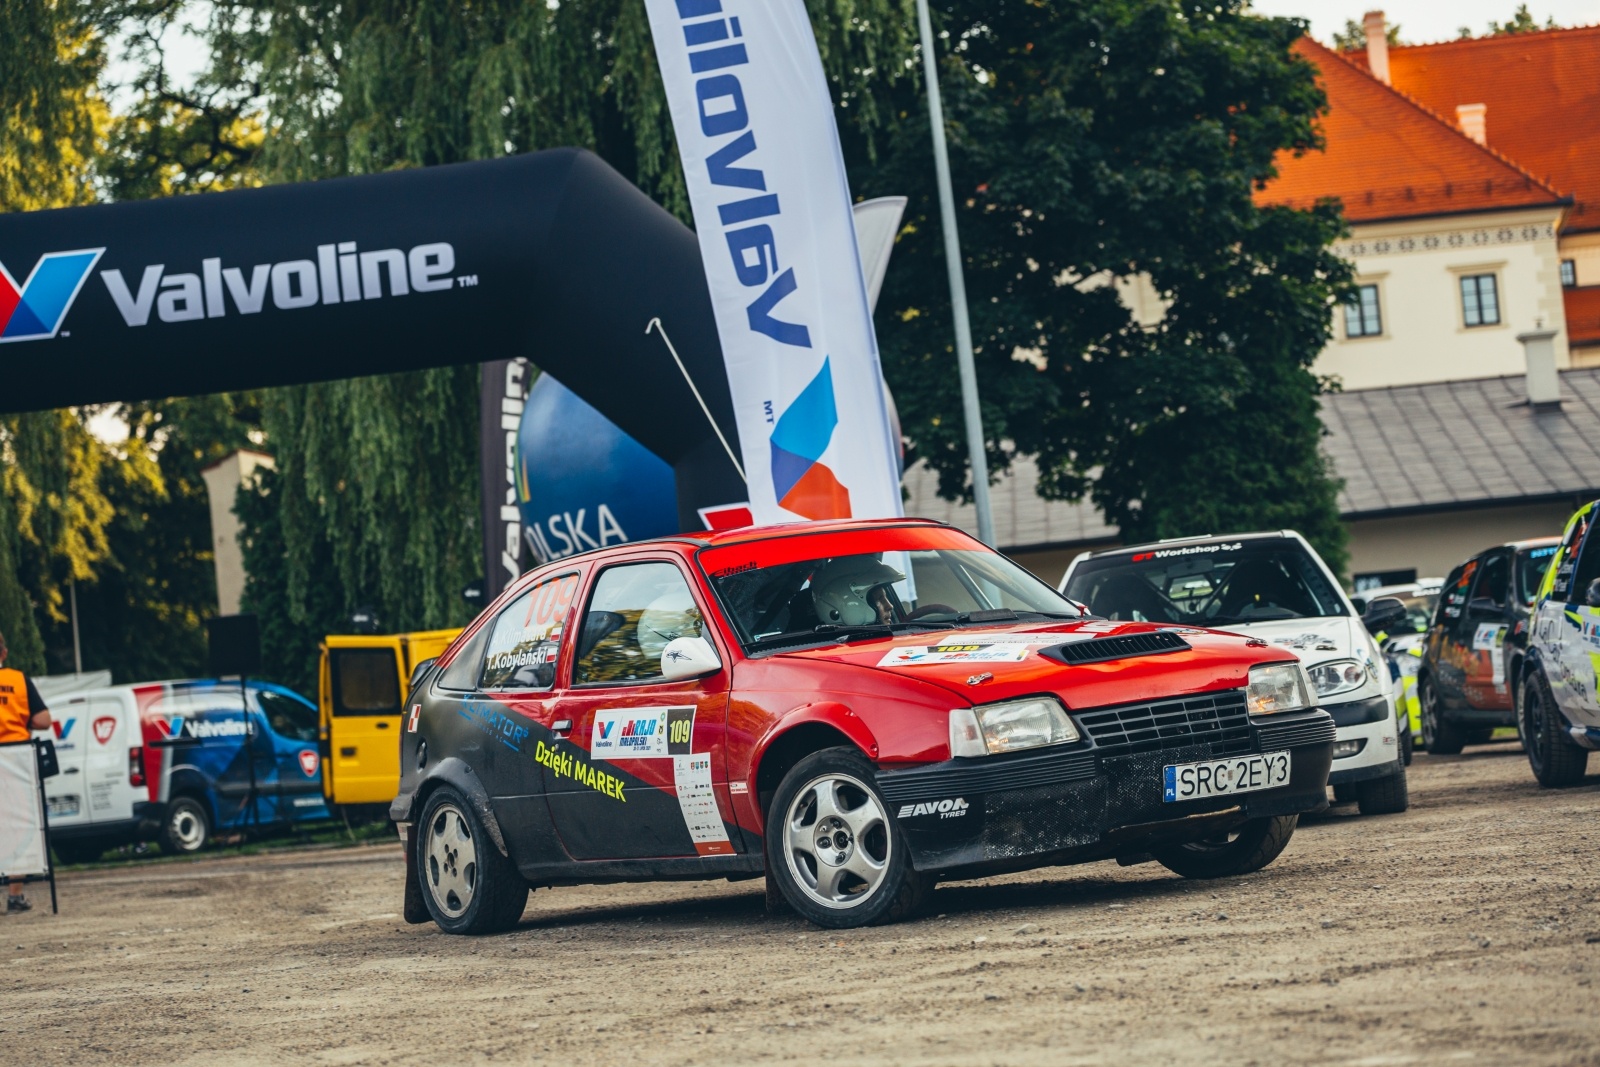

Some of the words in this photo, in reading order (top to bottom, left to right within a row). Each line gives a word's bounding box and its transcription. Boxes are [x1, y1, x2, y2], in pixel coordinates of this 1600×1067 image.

[101, 241, 456, 327] Valvoline
[528, 572, 579, 628] 109
[669, 719, 691, 744] 109
[535, 740, 573, 778] Dzięki
[574, 760, 627, 803] MAREK
[1181, 764, 1228, 796] SRC
[1236, 755, 1288, 789] 2EY3
[1166, 788, 1175, 797] PL
[940, 809, 967, 820] TYRES
